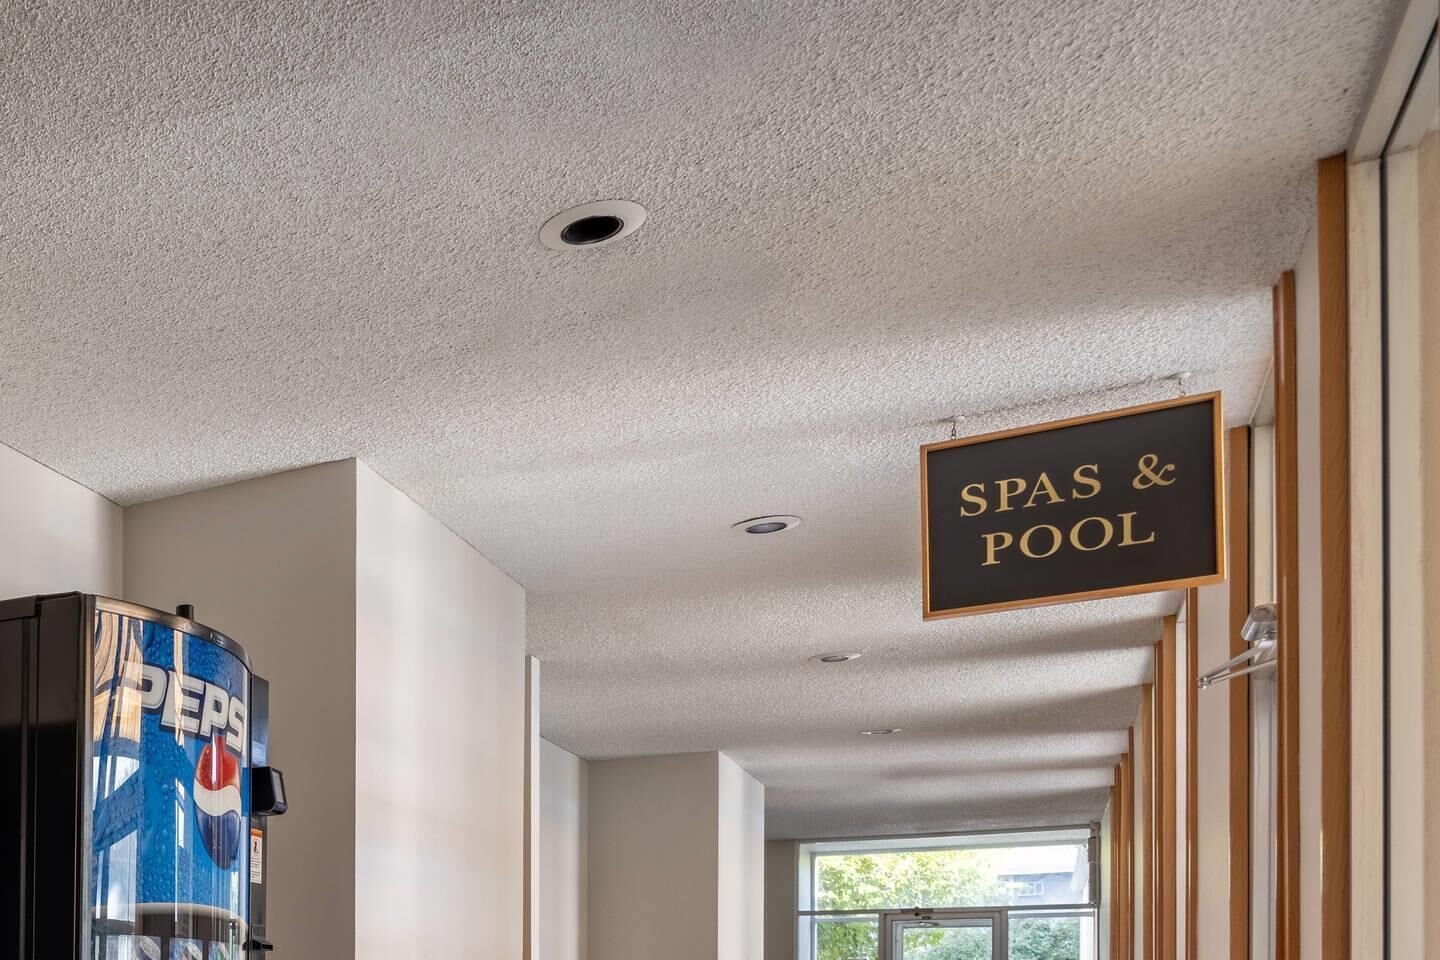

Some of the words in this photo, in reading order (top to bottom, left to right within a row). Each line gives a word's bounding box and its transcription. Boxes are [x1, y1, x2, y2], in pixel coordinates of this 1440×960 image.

[960, 463, 1103, 518] SPAS
[1132, 453, 1176, 490] &
[981, 511, 1155, 566] POOL
[115, 660, 248, 754] PEPS
